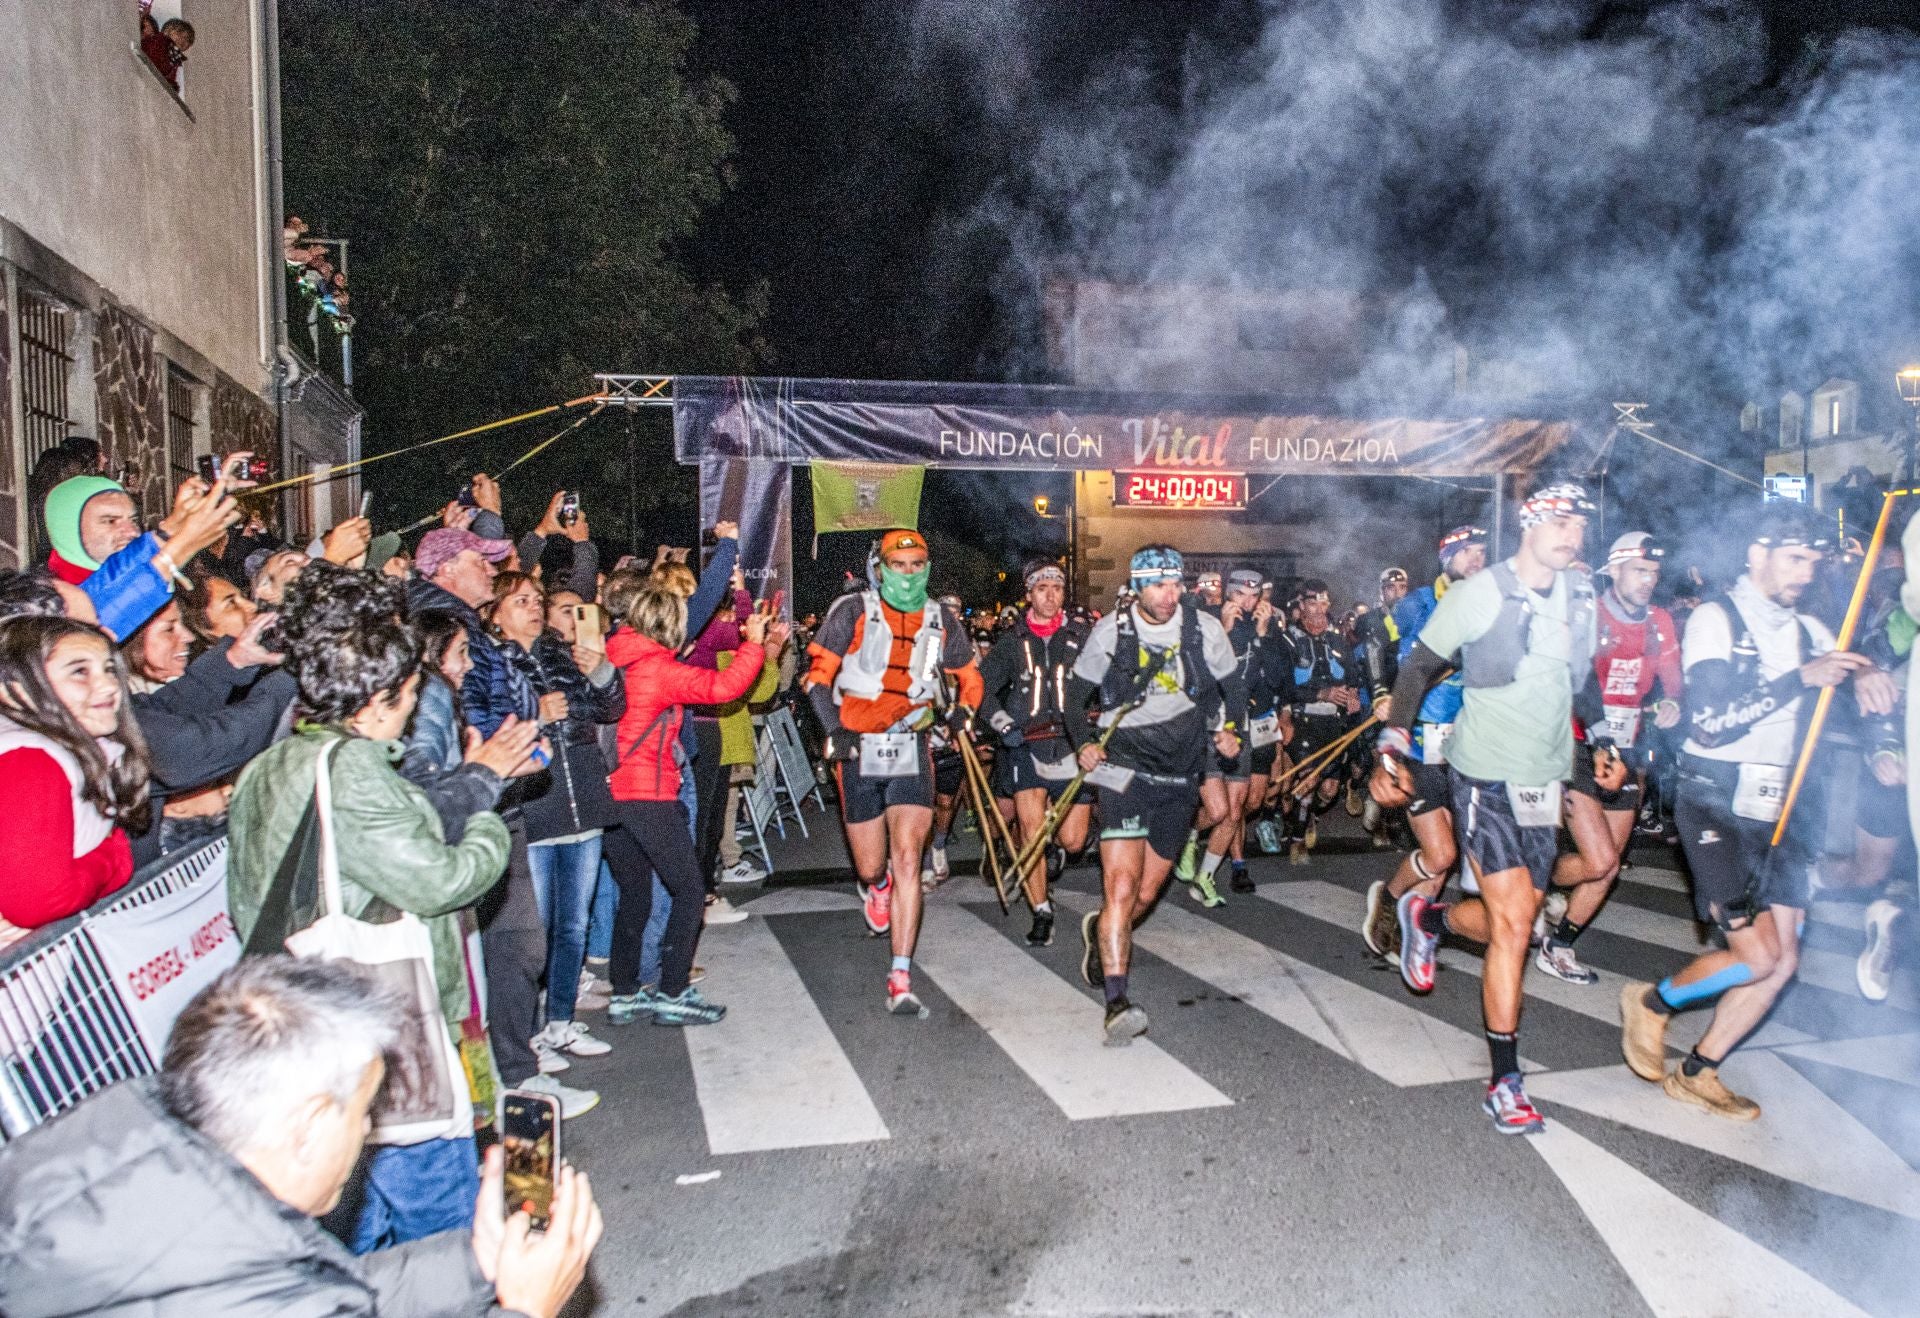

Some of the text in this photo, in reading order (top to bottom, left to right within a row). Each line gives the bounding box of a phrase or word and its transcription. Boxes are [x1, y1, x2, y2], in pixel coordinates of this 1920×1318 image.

[939, 417, 1399, 467] FUNDACIÓN Vital FUNDAZIOA
[1129, 476, 1233, 500] 24:00:04
[877, 748, 899, 758] 681
[1518, 790, 1546, 803] 1061
